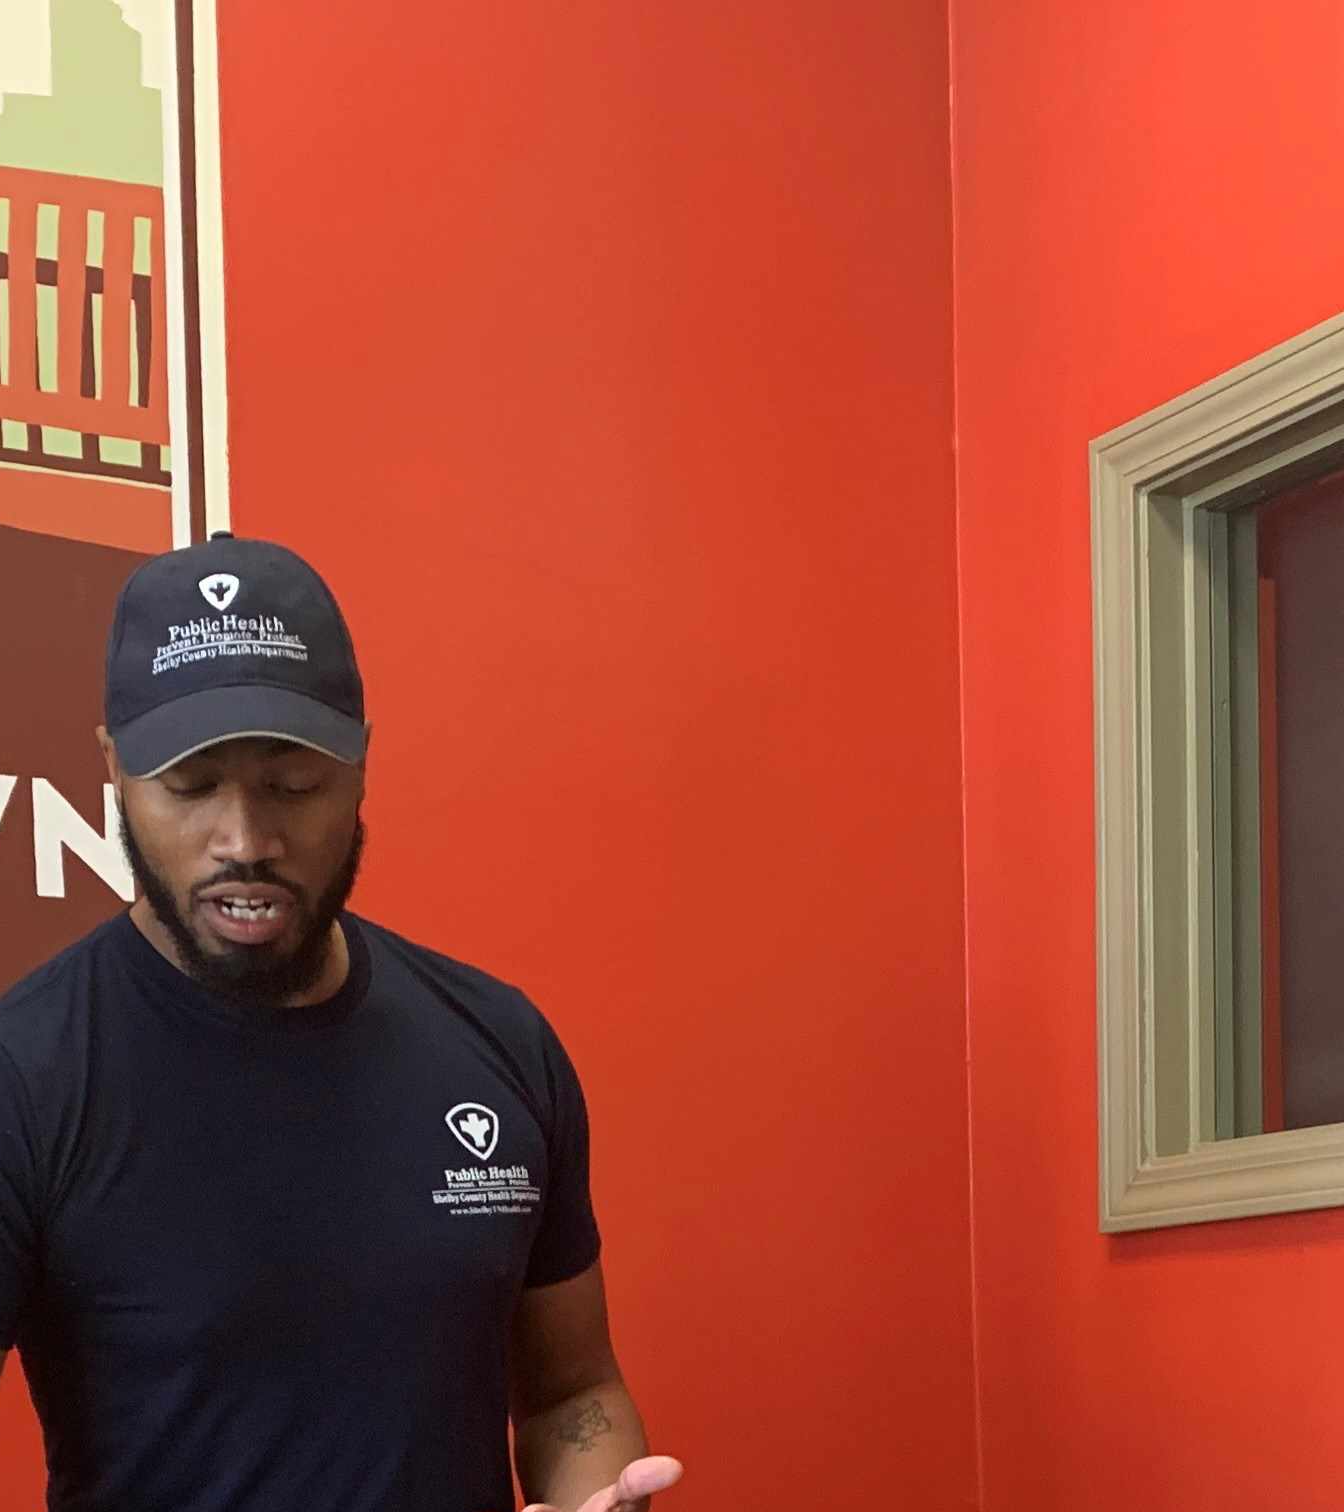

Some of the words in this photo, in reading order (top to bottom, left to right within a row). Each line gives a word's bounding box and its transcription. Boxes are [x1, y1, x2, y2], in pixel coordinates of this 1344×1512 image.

[167, 617, 221, 641] Public
[222, 614, 285, 634] Health
[152, 655, 181, 675] Shelby
[444, 1167, 488, 1182] Public
[488, 1165, 529, 1180] Health
